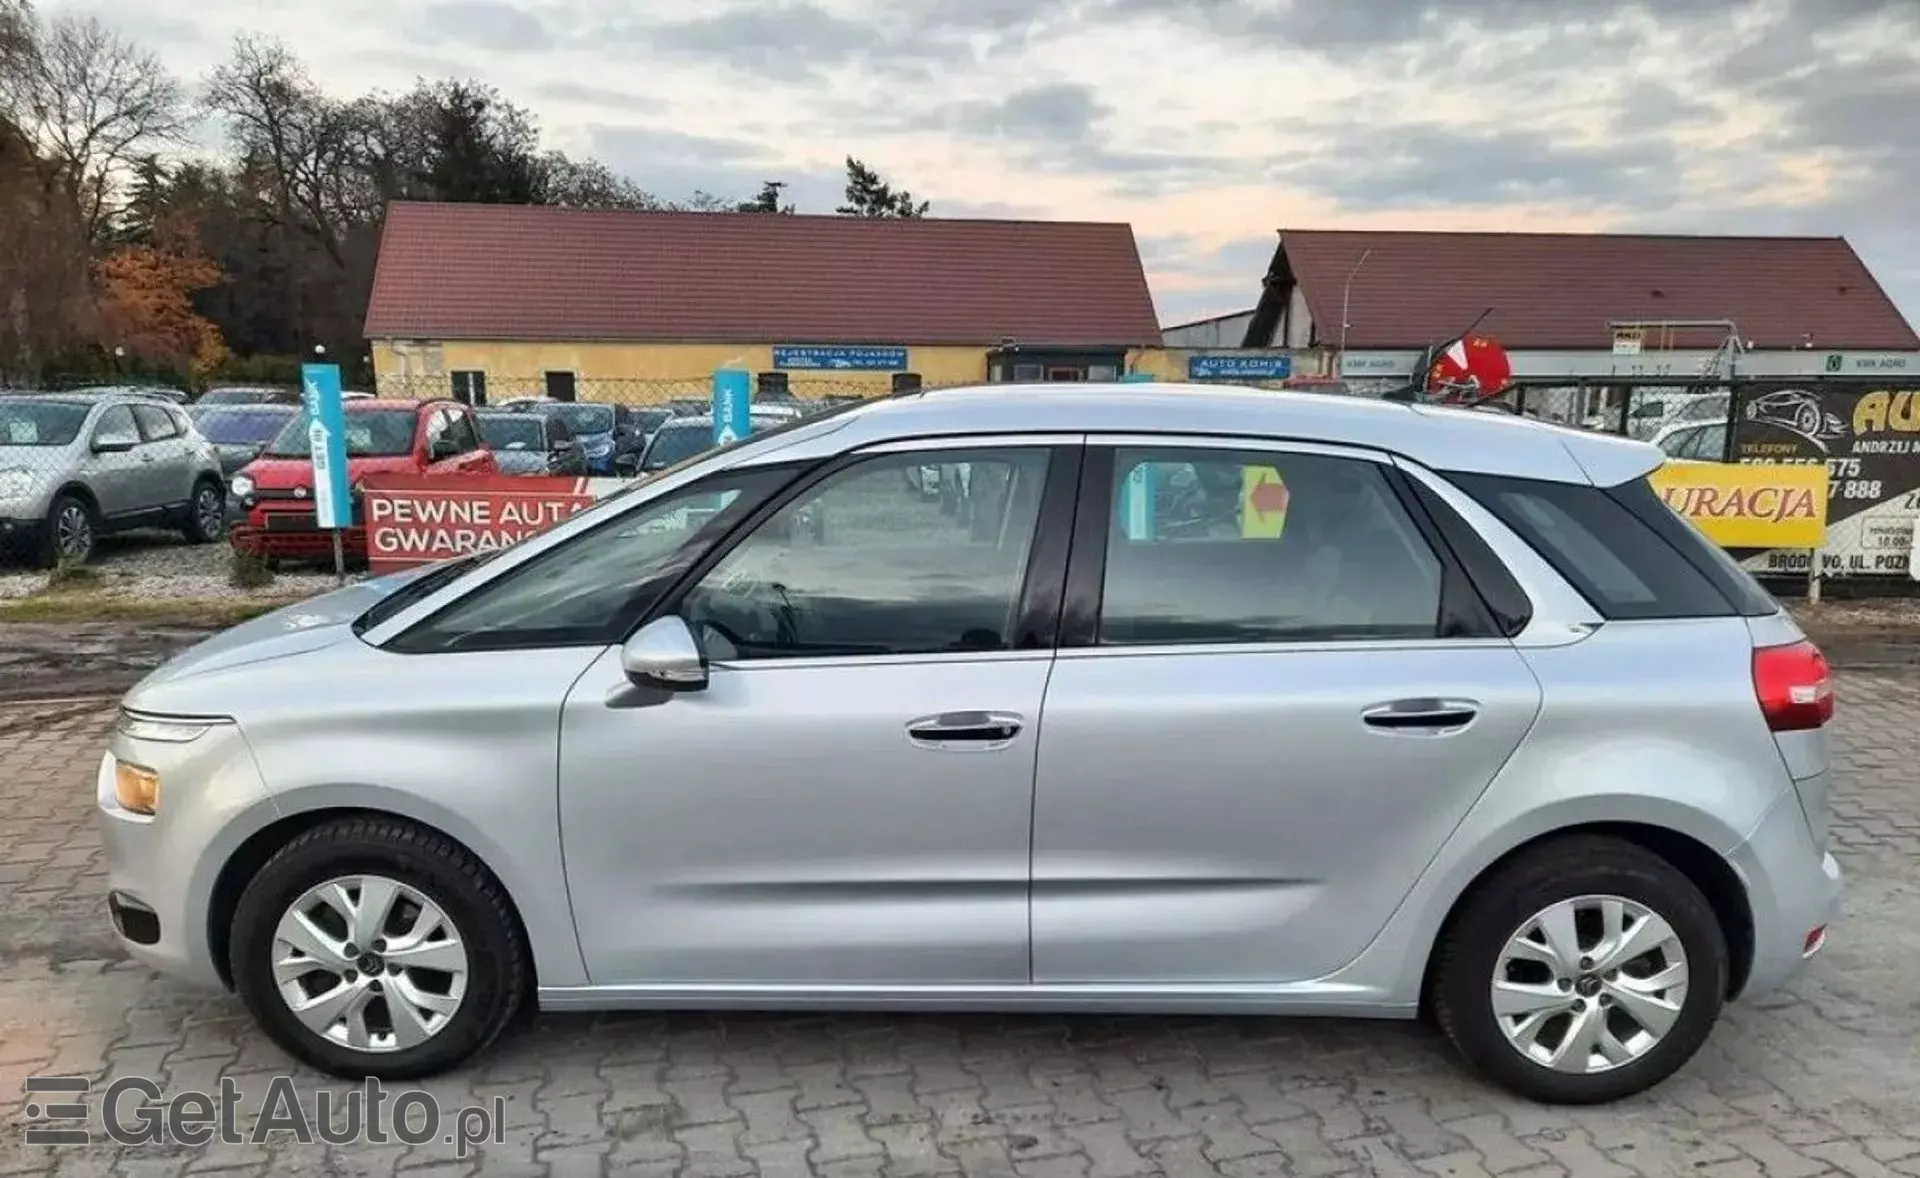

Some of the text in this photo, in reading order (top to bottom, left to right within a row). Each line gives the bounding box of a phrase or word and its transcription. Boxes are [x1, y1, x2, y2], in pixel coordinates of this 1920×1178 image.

[1852, 440, 1910, 454] ANDRZEJ
[1844, 480, 1882, 499] 888
[371, 498, 491, 525] PEWNE
